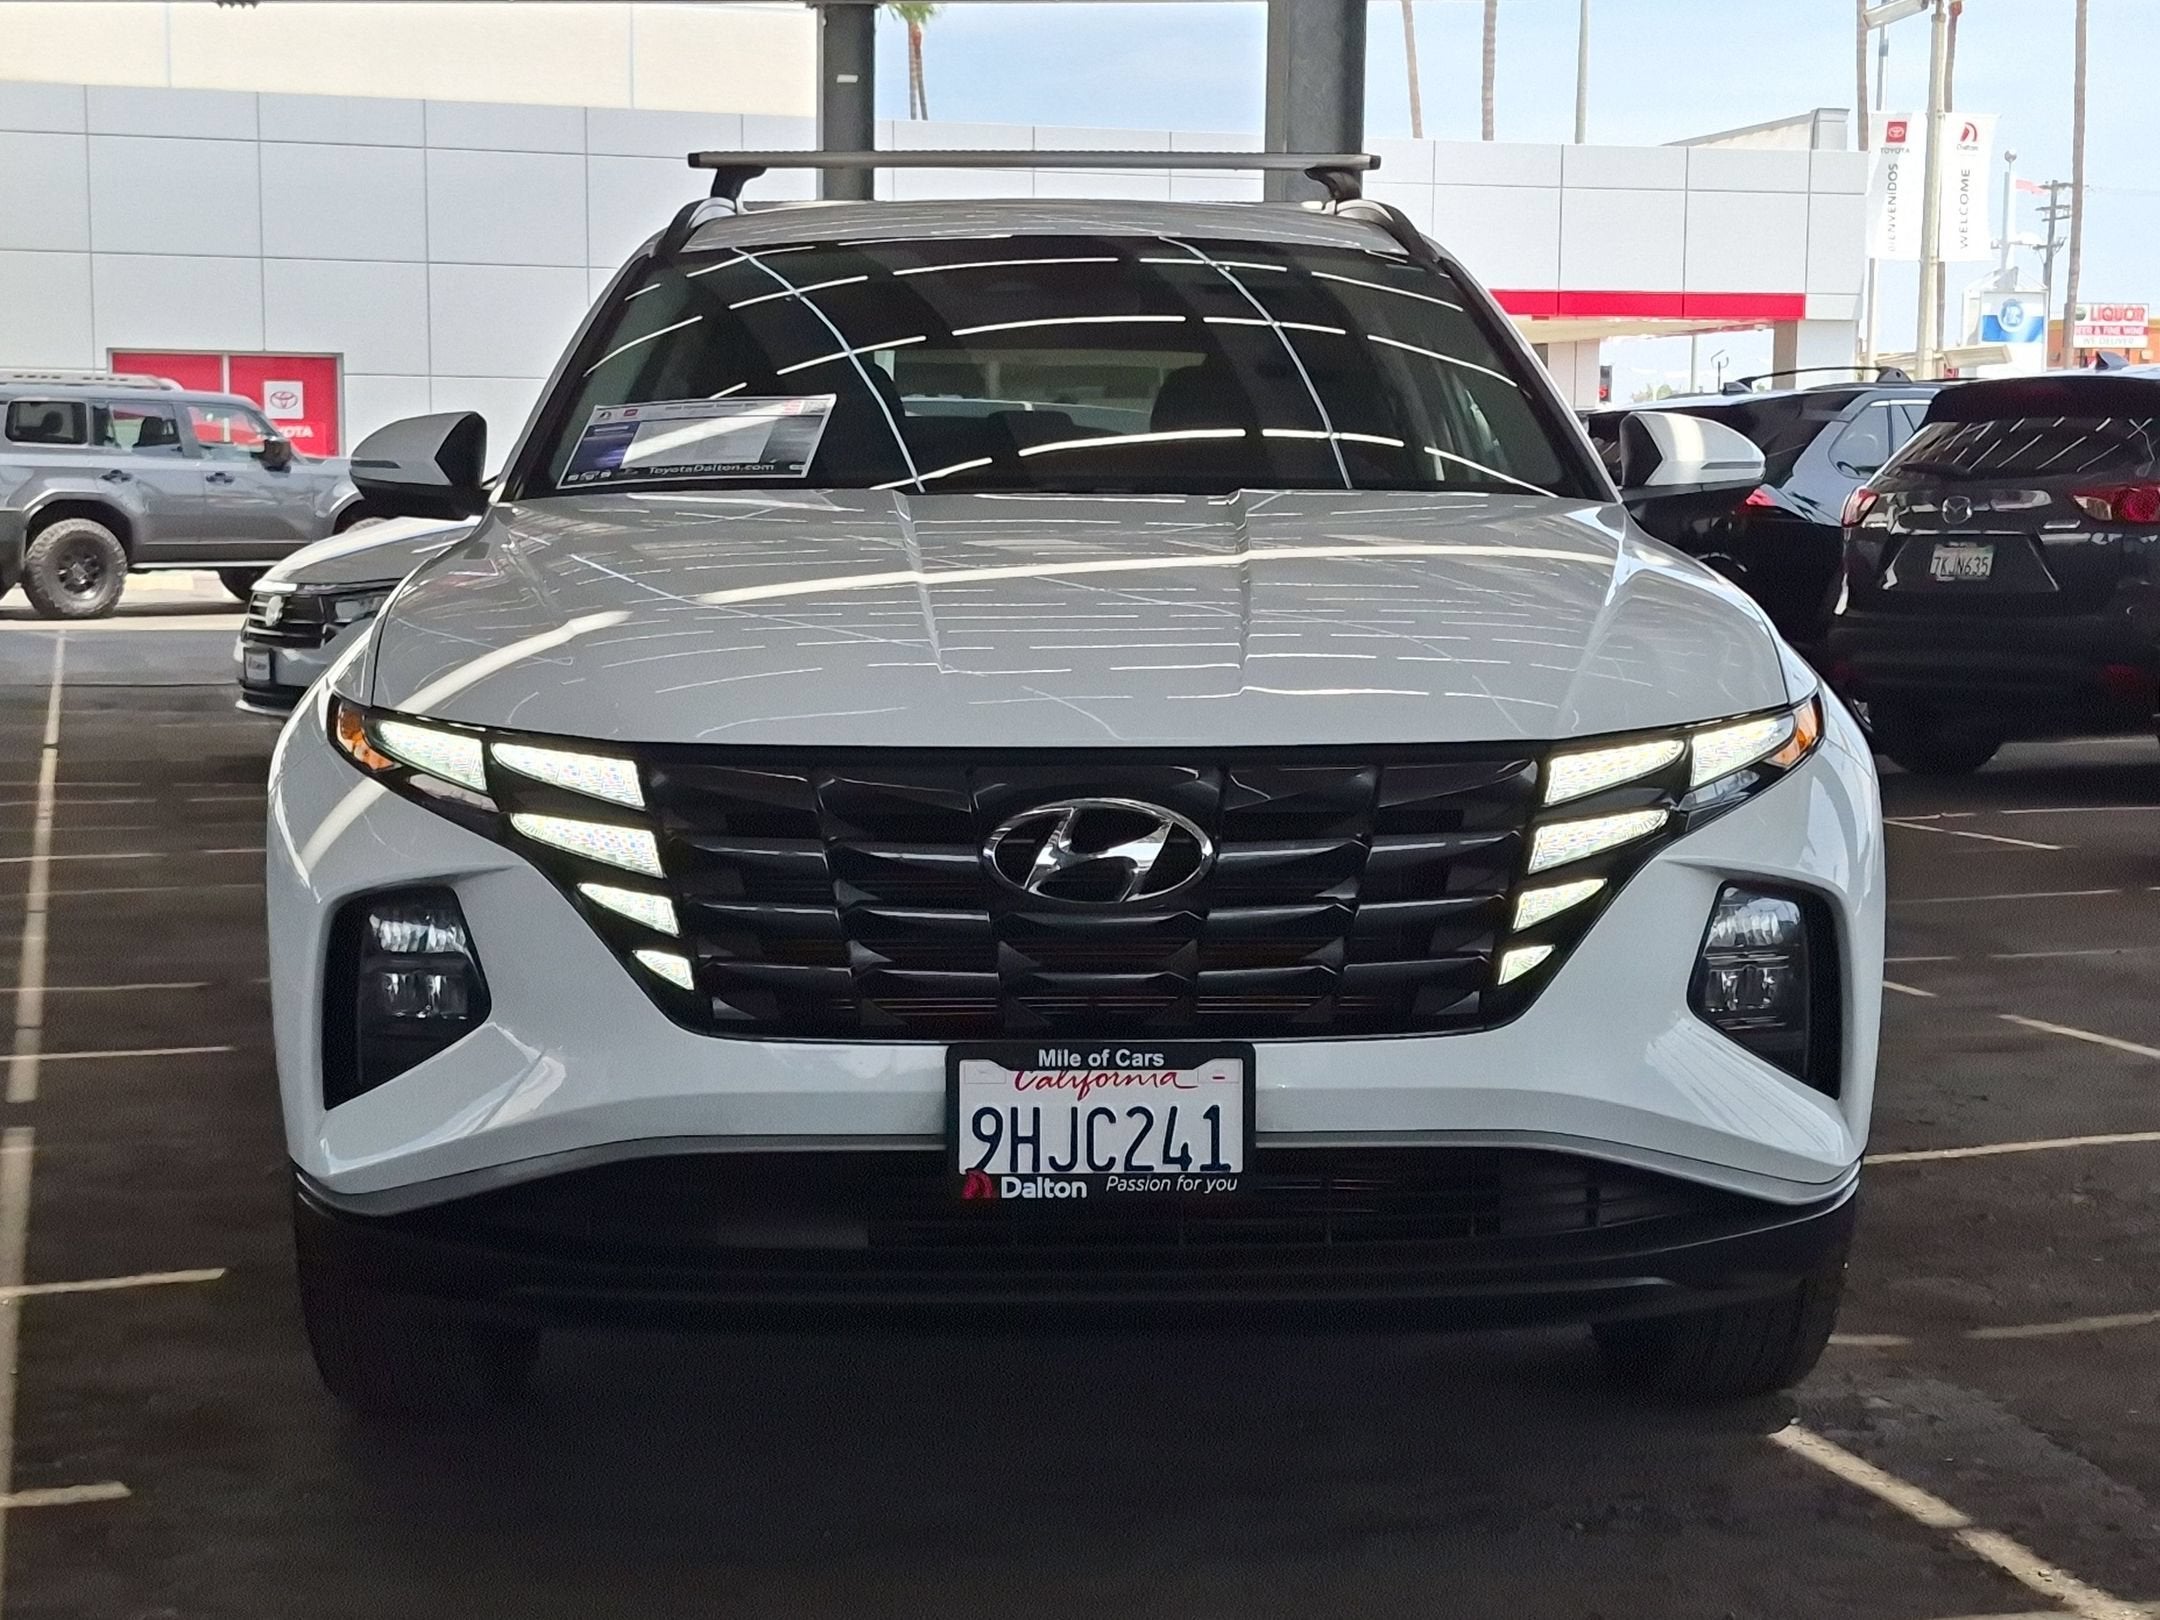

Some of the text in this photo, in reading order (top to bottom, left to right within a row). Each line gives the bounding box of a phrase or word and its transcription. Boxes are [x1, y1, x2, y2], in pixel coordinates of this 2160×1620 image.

[1959, 168, 1970, 249] WELCOME
[2090, 305, 2145, 321] LIQUOR
[649, 463, 775, 475] ToyotaDalton.com
[1038, 1049, 1165, 1067] Mile of Cars
[1014, 1070, 1199, 1101] California
[971, 1104, 1232, 1173] 9HJC241
[1001, 1175, 1238, 1199] Dalton Passion for you
